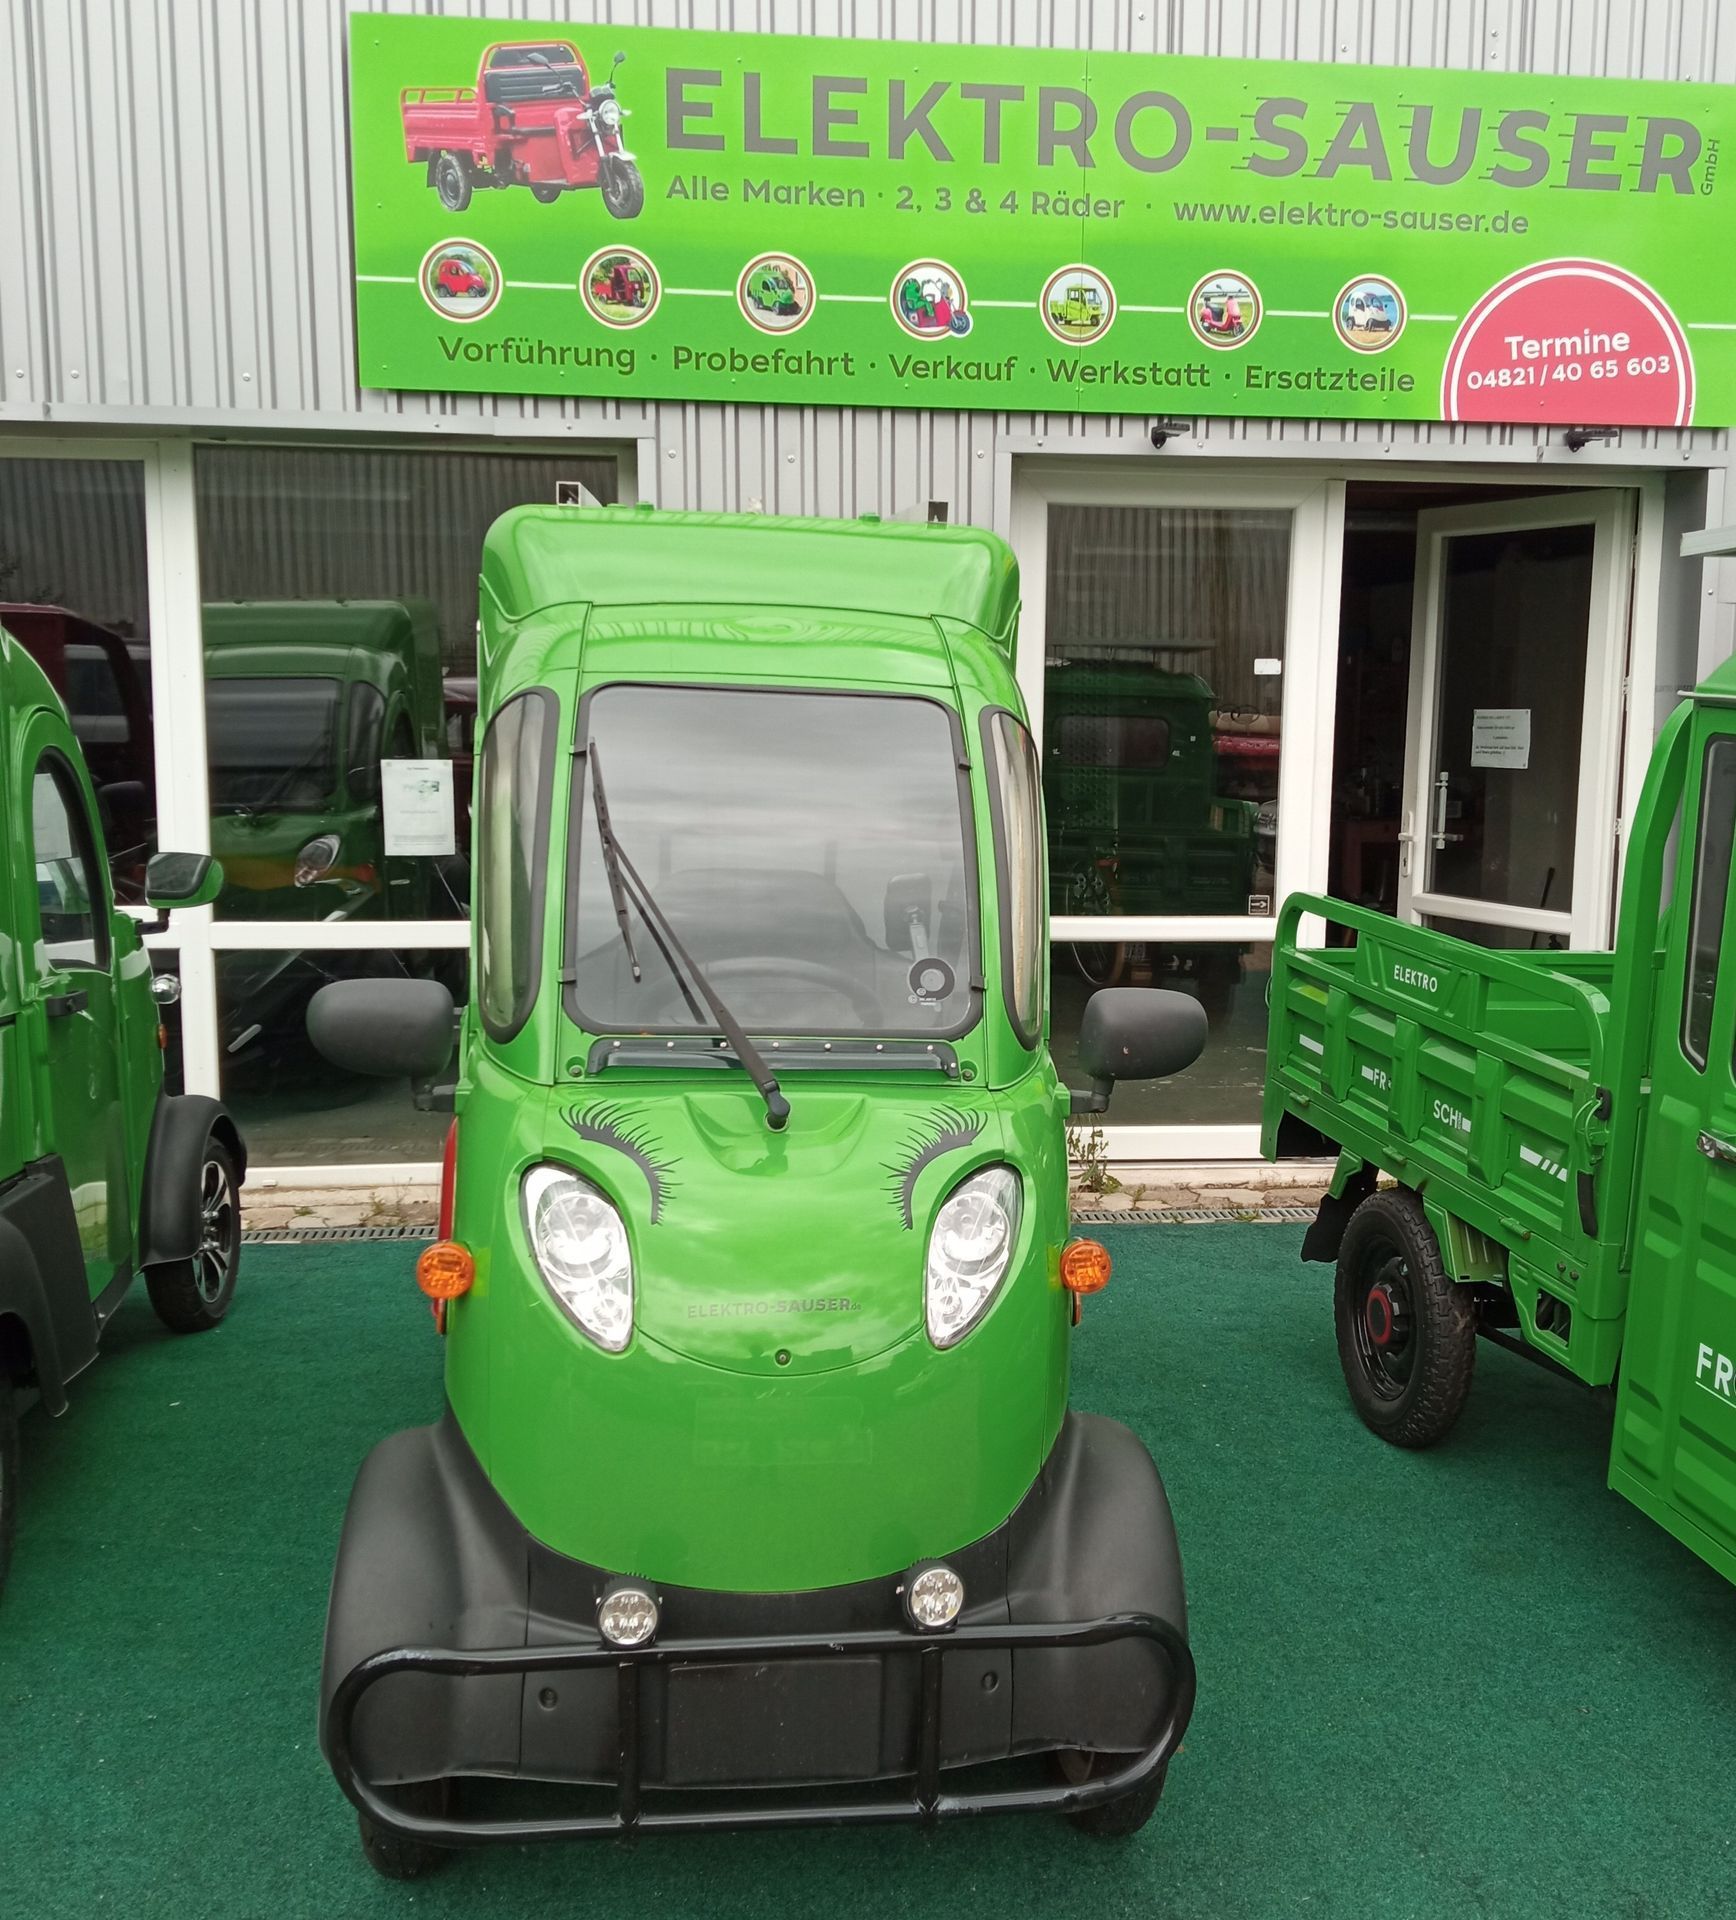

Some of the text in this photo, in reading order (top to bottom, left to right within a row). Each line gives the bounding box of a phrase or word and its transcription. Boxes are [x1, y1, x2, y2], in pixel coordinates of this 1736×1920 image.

[665, 67, 1702, 195] ELEKTRO-SAUSER
[1700, 138, 1720, 196] GmbH
[665, 174, 1530, 235] Alle Marken 2, 3 & 4 Räder www.elektro-sauser.de
[437, 335, 1415, 392] Vorführung Probefahrt Verkauf Werkstatt Ersatzteile
[1504, 327, 1631, 361] Termine
[1589, 359, 1619, 380] 65
[1625, 355, 1671, 377] 603
[1393, 964, 1439, 993] ELEKTRO
[1695, 1341, 1736, 1398] FR
